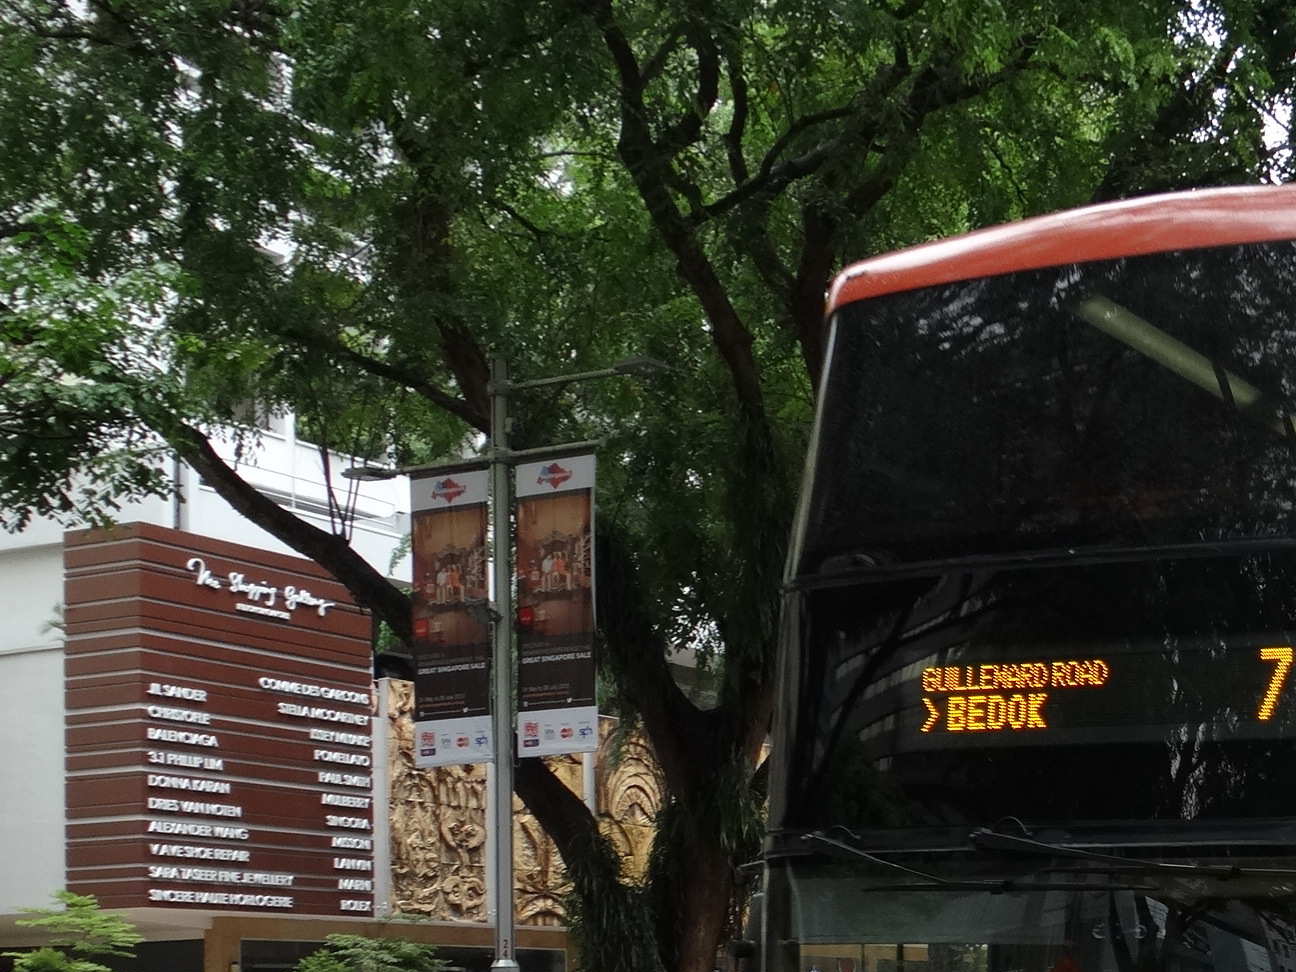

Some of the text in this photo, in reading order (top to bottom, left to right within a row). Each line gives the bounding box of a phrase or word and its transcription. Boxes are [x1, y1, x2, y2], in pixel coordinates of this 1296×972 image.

[186, 558, 221, 589] The
[228, 571, 277, 606] Shopping
[284, 585, 336, 617] Gallery
[522, 656, 541, 664] GREAT
[541, 652, 576, 663] SINGAPORE
[576, 651, 592, 659] SALE
[417, 667, 437, 676] GREAT
[437, 663, 470, 673] SINGAPORE
[470, 661, 486, 669] SALE
[922, 659, 1110, 693] GUILLEMARD ROAD
[162, 684, 207, 702] SANDER
[259, 677, 301, 694] COMME
[301, 684, 320, 696] DES
[1257, 647, 1294, 721] 7
[147, 705, 211, 725] CHRISTOFLE
[277, 702, 312, 717] STELLA
[946, 693, 1049, 731] BEDOK
[147, 728, 219, 747] BALENCIAGA
[309, 728, 371, 746] ISSEY MIYAKE
[203, 757, 223, 771] LIM
[313, 749, 370, 766] POMELLATO
[148, 775, 231, 794] DONNA KARAN
[318, 772, 371, 788] PAUL SMITH
[147, 797, 242, 818] DRIES VAN NOTEN
[321, 793, 371, 809] MULBERRY
[147, 821, 250, 840] ALEXANDER WANG
[183, 846, 214, 860] SHOE
[213, 848, 251, 862] REPAIR
[333, 857, 372, 870] LANVIN
[148, 866, 294, 886] SARA TASEER FINE JEWELLERY
[338, 878, 372, 891] MARNI
[148, 889, 294, 908] SINCERE HAUTE HORLOGERIE
[340, 899, 372, 911] ROLEX
